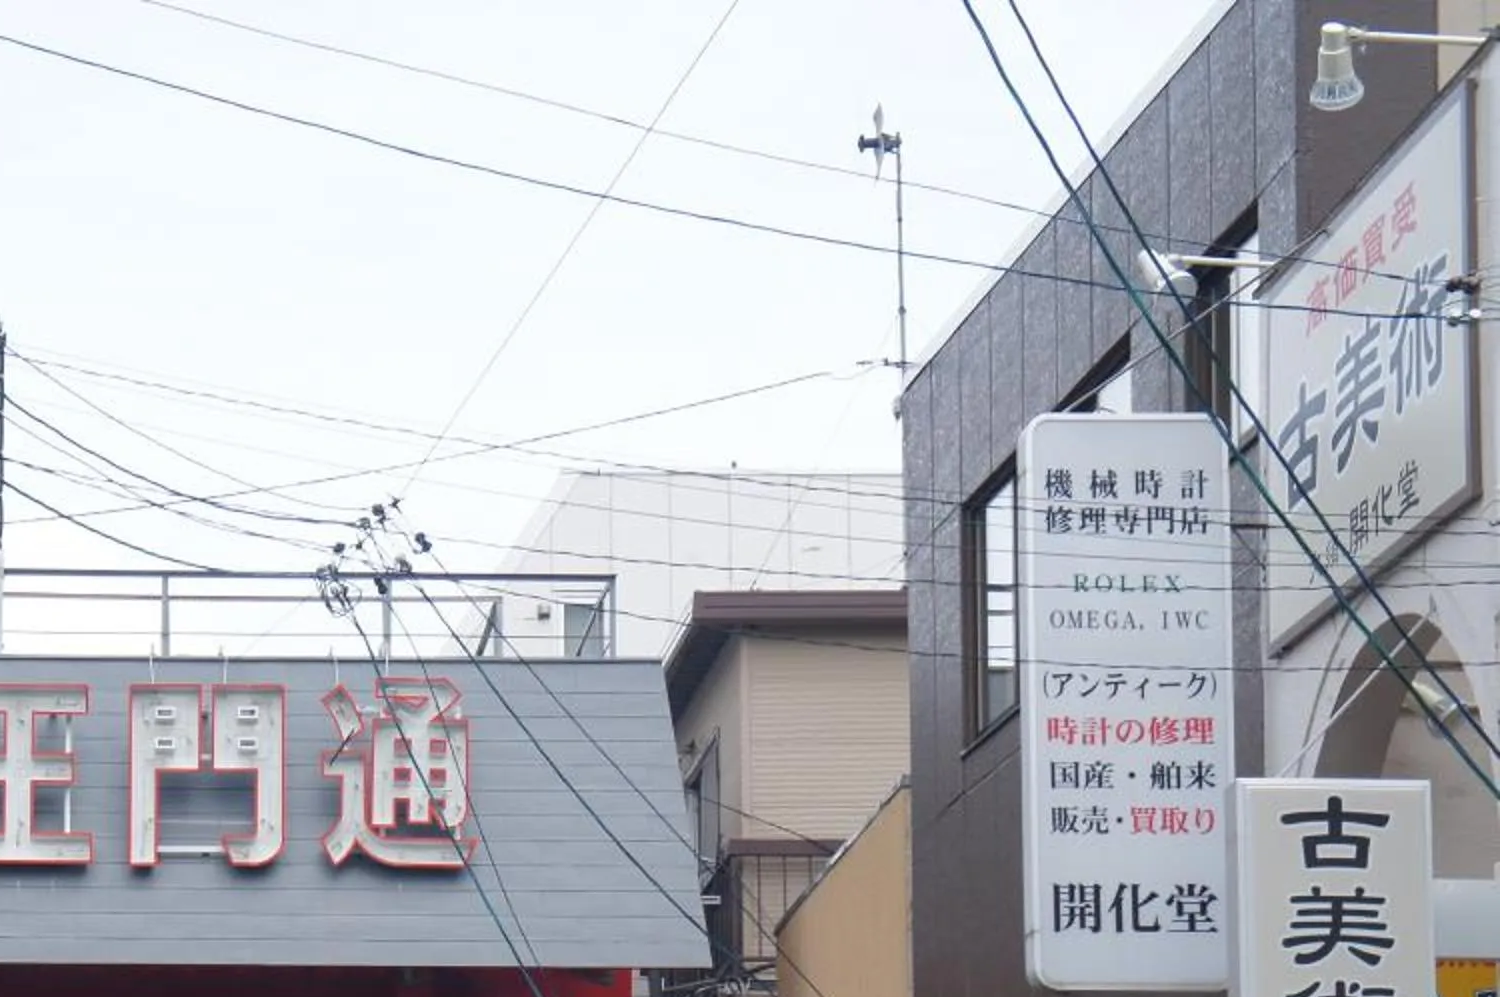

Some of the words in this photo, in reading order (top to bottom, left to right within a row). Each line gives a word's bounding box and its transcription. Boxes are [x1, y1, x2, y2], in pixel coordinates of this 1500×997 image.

[1276, 253, 1448, 511] 古美術
[1044, 469, 1208, 500] 機械時計
[1044, 505, 1208, 536] 修理専門店
[1073, 573, 1182, 594] ROLEX
[1161, 609, 1210, 631] IWC
[1043, 670, 1217, 700] (アンティーク)
[1046, 716, 1216, 747] 時計の修理
[1049, 761, 1217, 791] 国産・舶来
[1049, 805, 1217, 836] 販売・買取り
[1051, 882, 1220, 935] 開化堂
